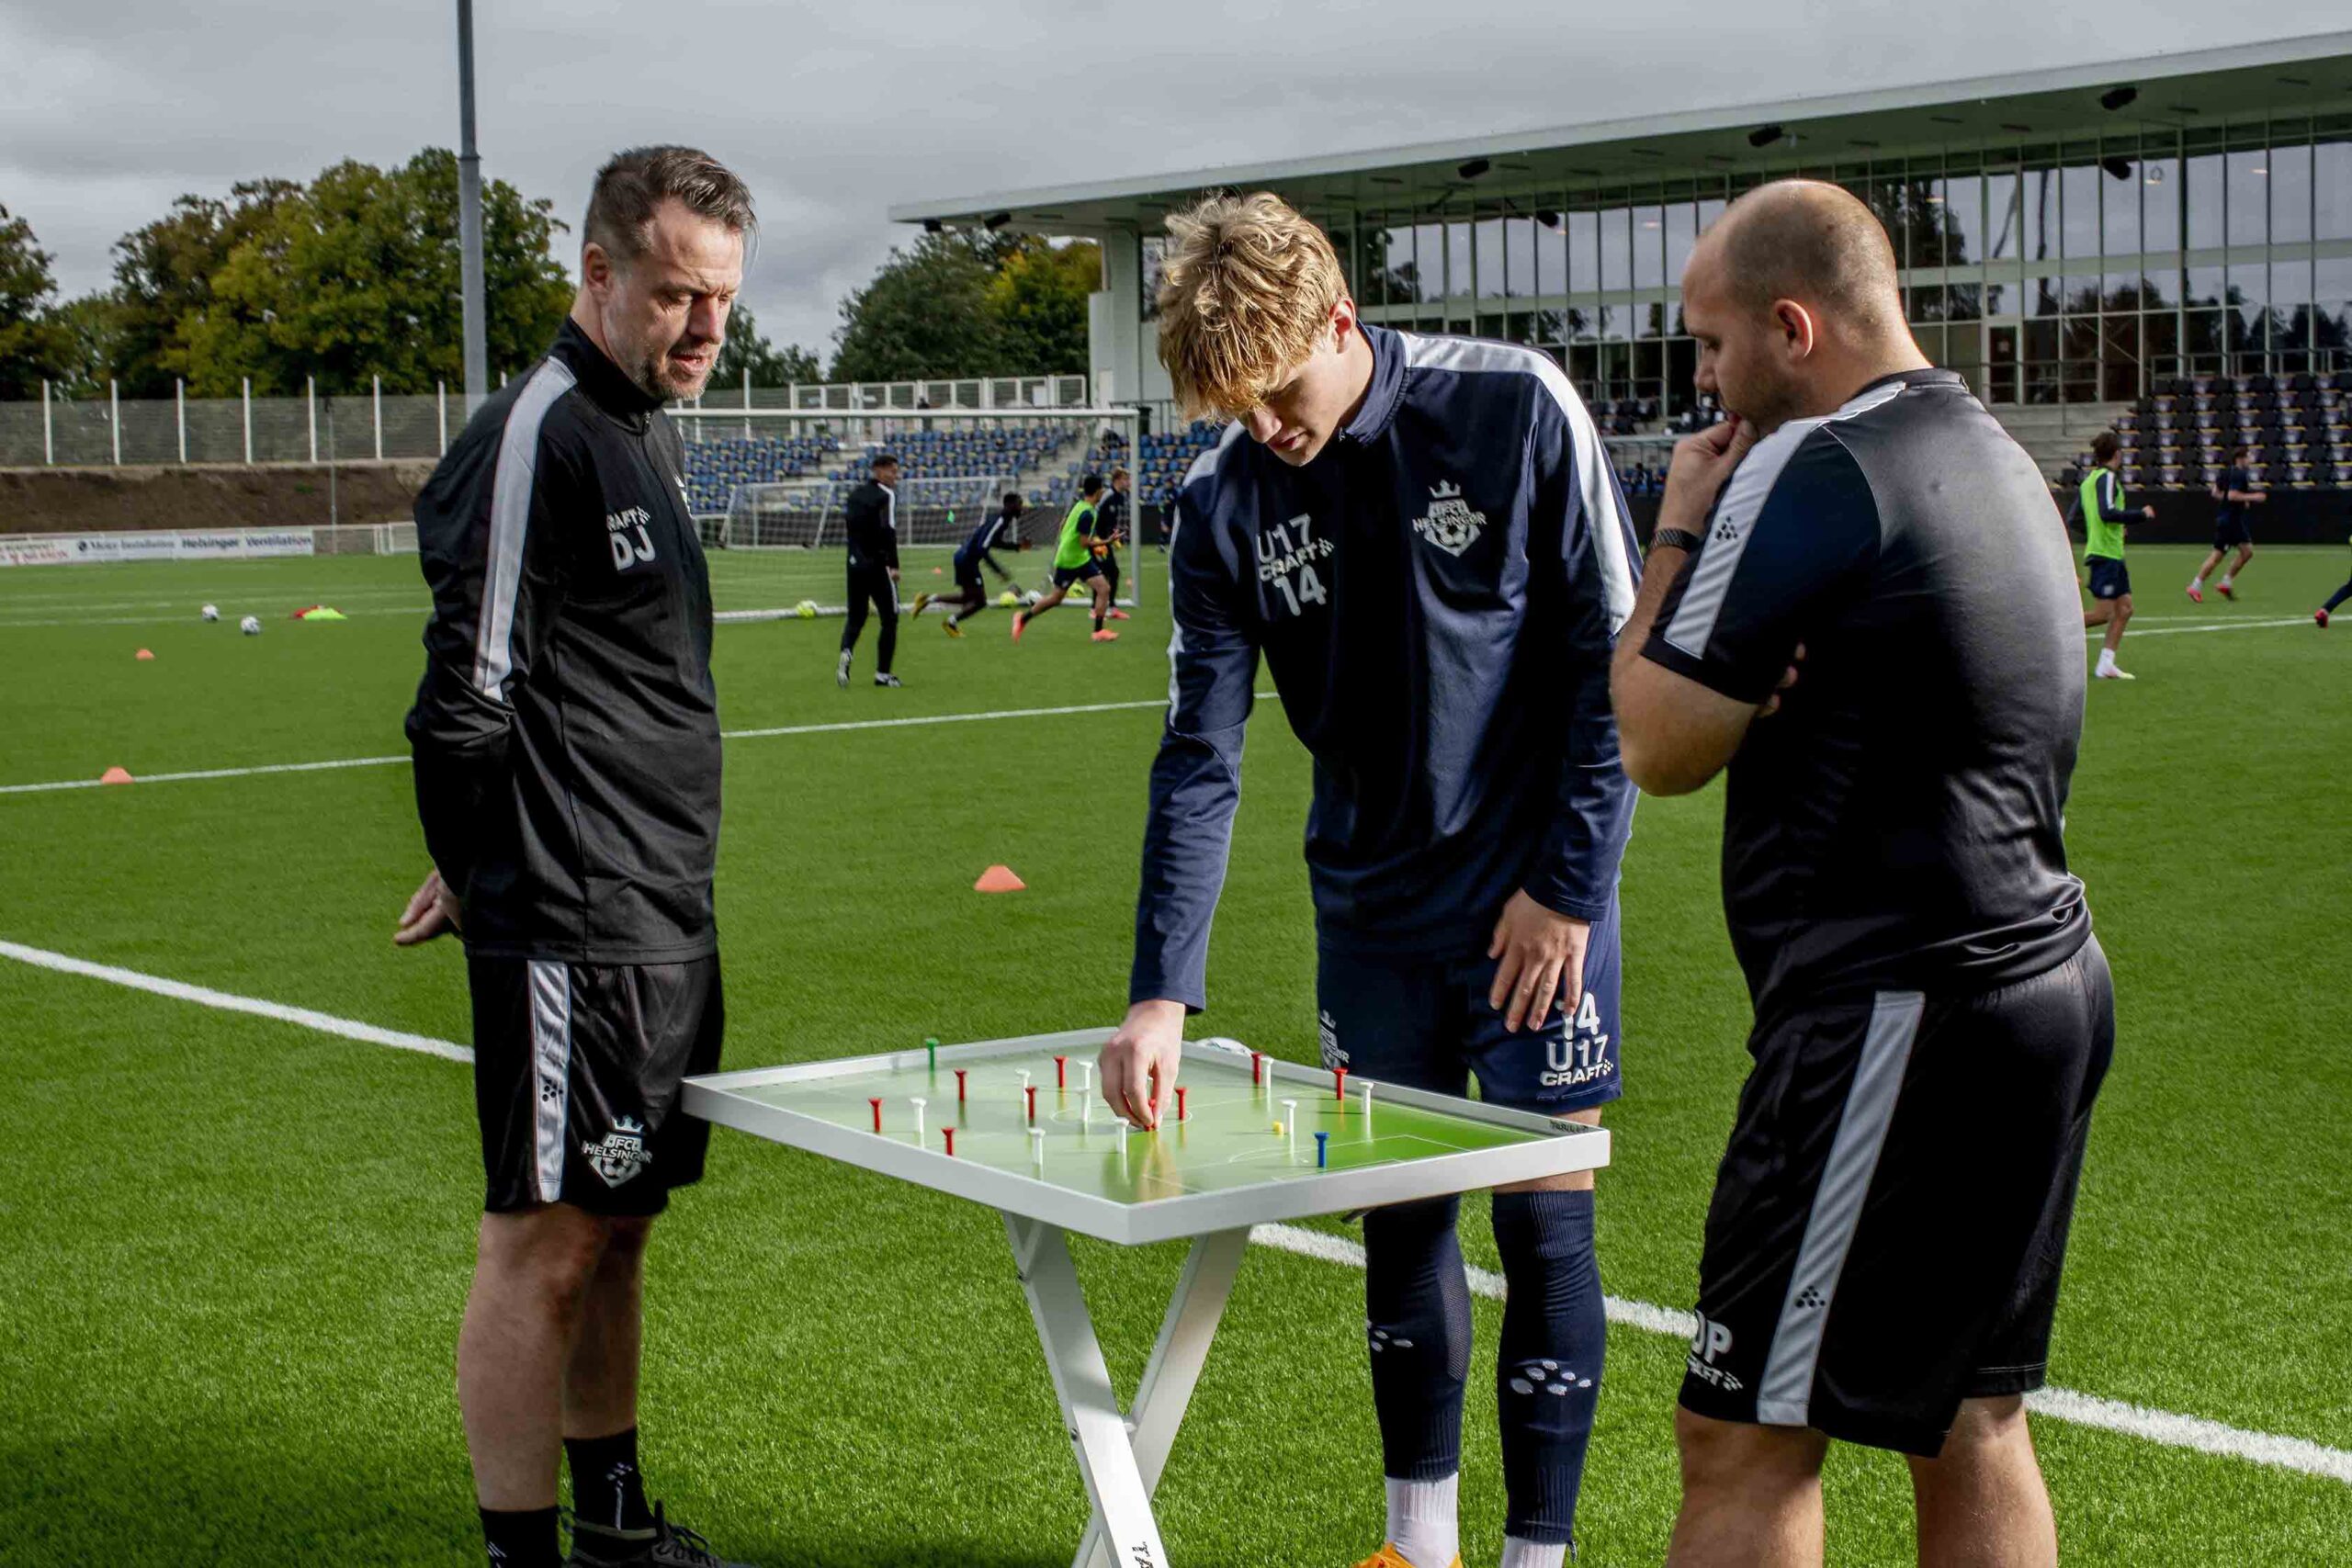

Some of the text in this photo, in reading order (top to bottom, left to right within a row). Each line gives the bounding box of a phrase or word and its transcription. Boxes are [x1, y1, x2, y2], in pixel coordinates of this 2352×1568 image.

[609, 525, 655, 570] DJ
[1256, 513, 1311, 563] U17
[1258, 541, 1317, 581] CRAFT
[1273, 564, 1327, 616] 14
[1555, 992, 1600, 1040] 14
[1540, 1063, 1603, 1087] CRAFT
[1546, 1035, 1608, 1072] U17
